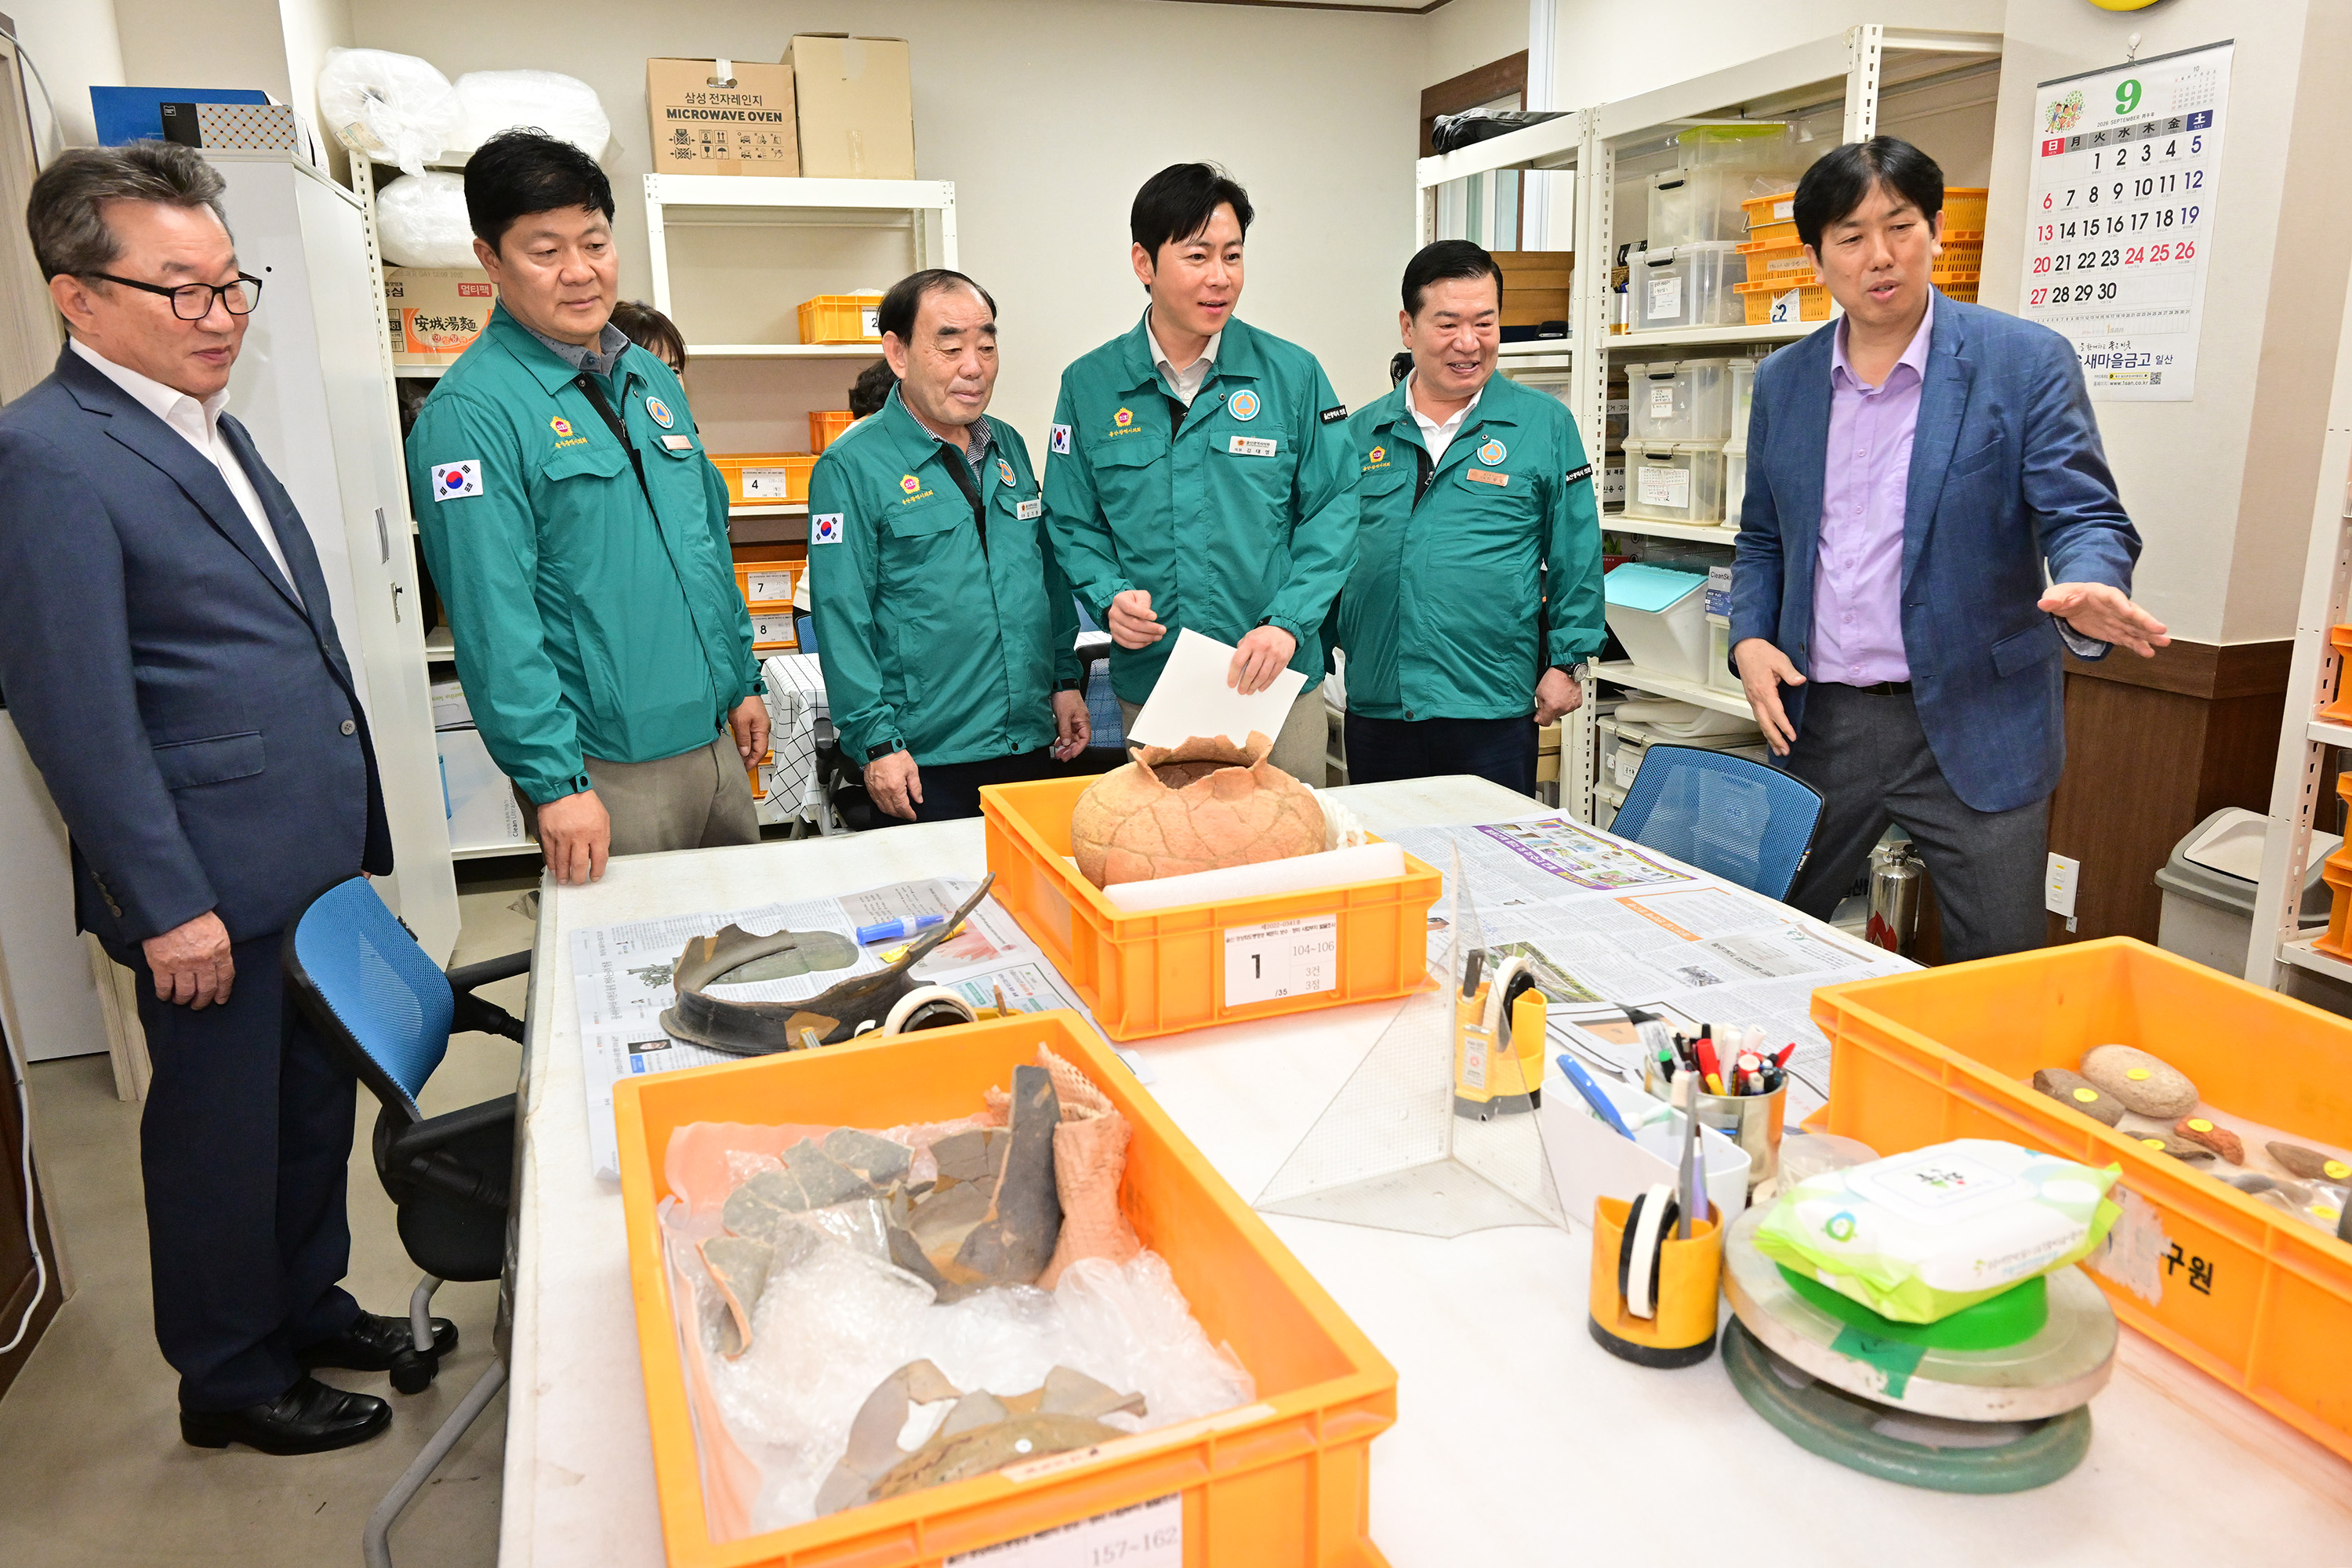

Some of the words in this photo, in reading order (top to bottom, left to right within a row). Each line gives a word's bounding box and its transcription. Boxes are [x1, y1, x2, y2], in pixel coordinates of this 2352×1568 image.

[685, 93, 706, 104] 삼성
[709, 93, 763, 107] 전자레인지
[2115, 79, 2142, 115] 9
[666, 108, 746, 121] MICROWAVE
[747, 111, 782, 122] OVEN
[2111, 115, 2140, 125] SEPTEMBER
[2049, 140, 2058, 151] 日
[2071, 136, 2081, 147] 月
[2094, 132, 2106, 143] 火
[2118, 127, 2130, 138] 水
[2143, 122, 2155, 133] 木
[2168, 118, 2180, 129] 金
[2193, 113, 2205, 125] 土
[2094, 153, 2100, 169] 1
[2116, 148, 2127, 166] 2
[2141, 144, 2151, 162] 3
[2165, 140, 2176, 158] 4
[2190, 135, 2201, 154] 5
[2043, 193, 2053, 209] 6
[2067, 189, 2075, 206] 7
[2089, 186, 2098, 203] 8
[2113, 182, 2124, 200] 9
[2135, 178, 2153, 197] 10
[2160, 174, 2176, 194] 11
[2185, 170, 2204, 190] 12
[2038, 224, 2053, 241] 13
[2060, 221, 2076, 239] 14
[2083, 219, 2100, 237] 15
[2107, 216, 2124, 234] 16
[2131, 212, 2149, 231] 17
[2156, 209, 2173, 228] 18
[2181, 205, 2200, 225] 19
[2033, 256, 2051, 274] 20
[2055, 254, 2071, 271] 21
[2078, 252, 2096, 270] 22
[2100, 249, 2119, 267] 23
[2125, 246, 2144, 265] 24
[2150, 244, 2170, 263] 25
[2175, 241, 2195, 260] 26
[460, 285, 490, 296] 멀티팩
[2031, 288, 2048, 305] 27
[2052, 286, 2070, 303] 28
[2074, 284, 2093, 302] 29
[2097, 282, 2117, 300] 30
[414, 315, 478, 332] 安城湯麵
[2084, 353, 2151, 369] 새마을금고
[2155, 354, 2173, 365] 일산
[752, 480, 758, 489] 4
[757, 583, 764, 593] 7
[760, 625, 767, 634] 8
[1251, 954, 1261, 979] 1
[1293, 941, 1335, 956] 104~106
[1305, 965, 1320, 978] 3건
[1275, 989, 1288, 997] /35
[1092, 1526, 1179, 1567] 157~162
